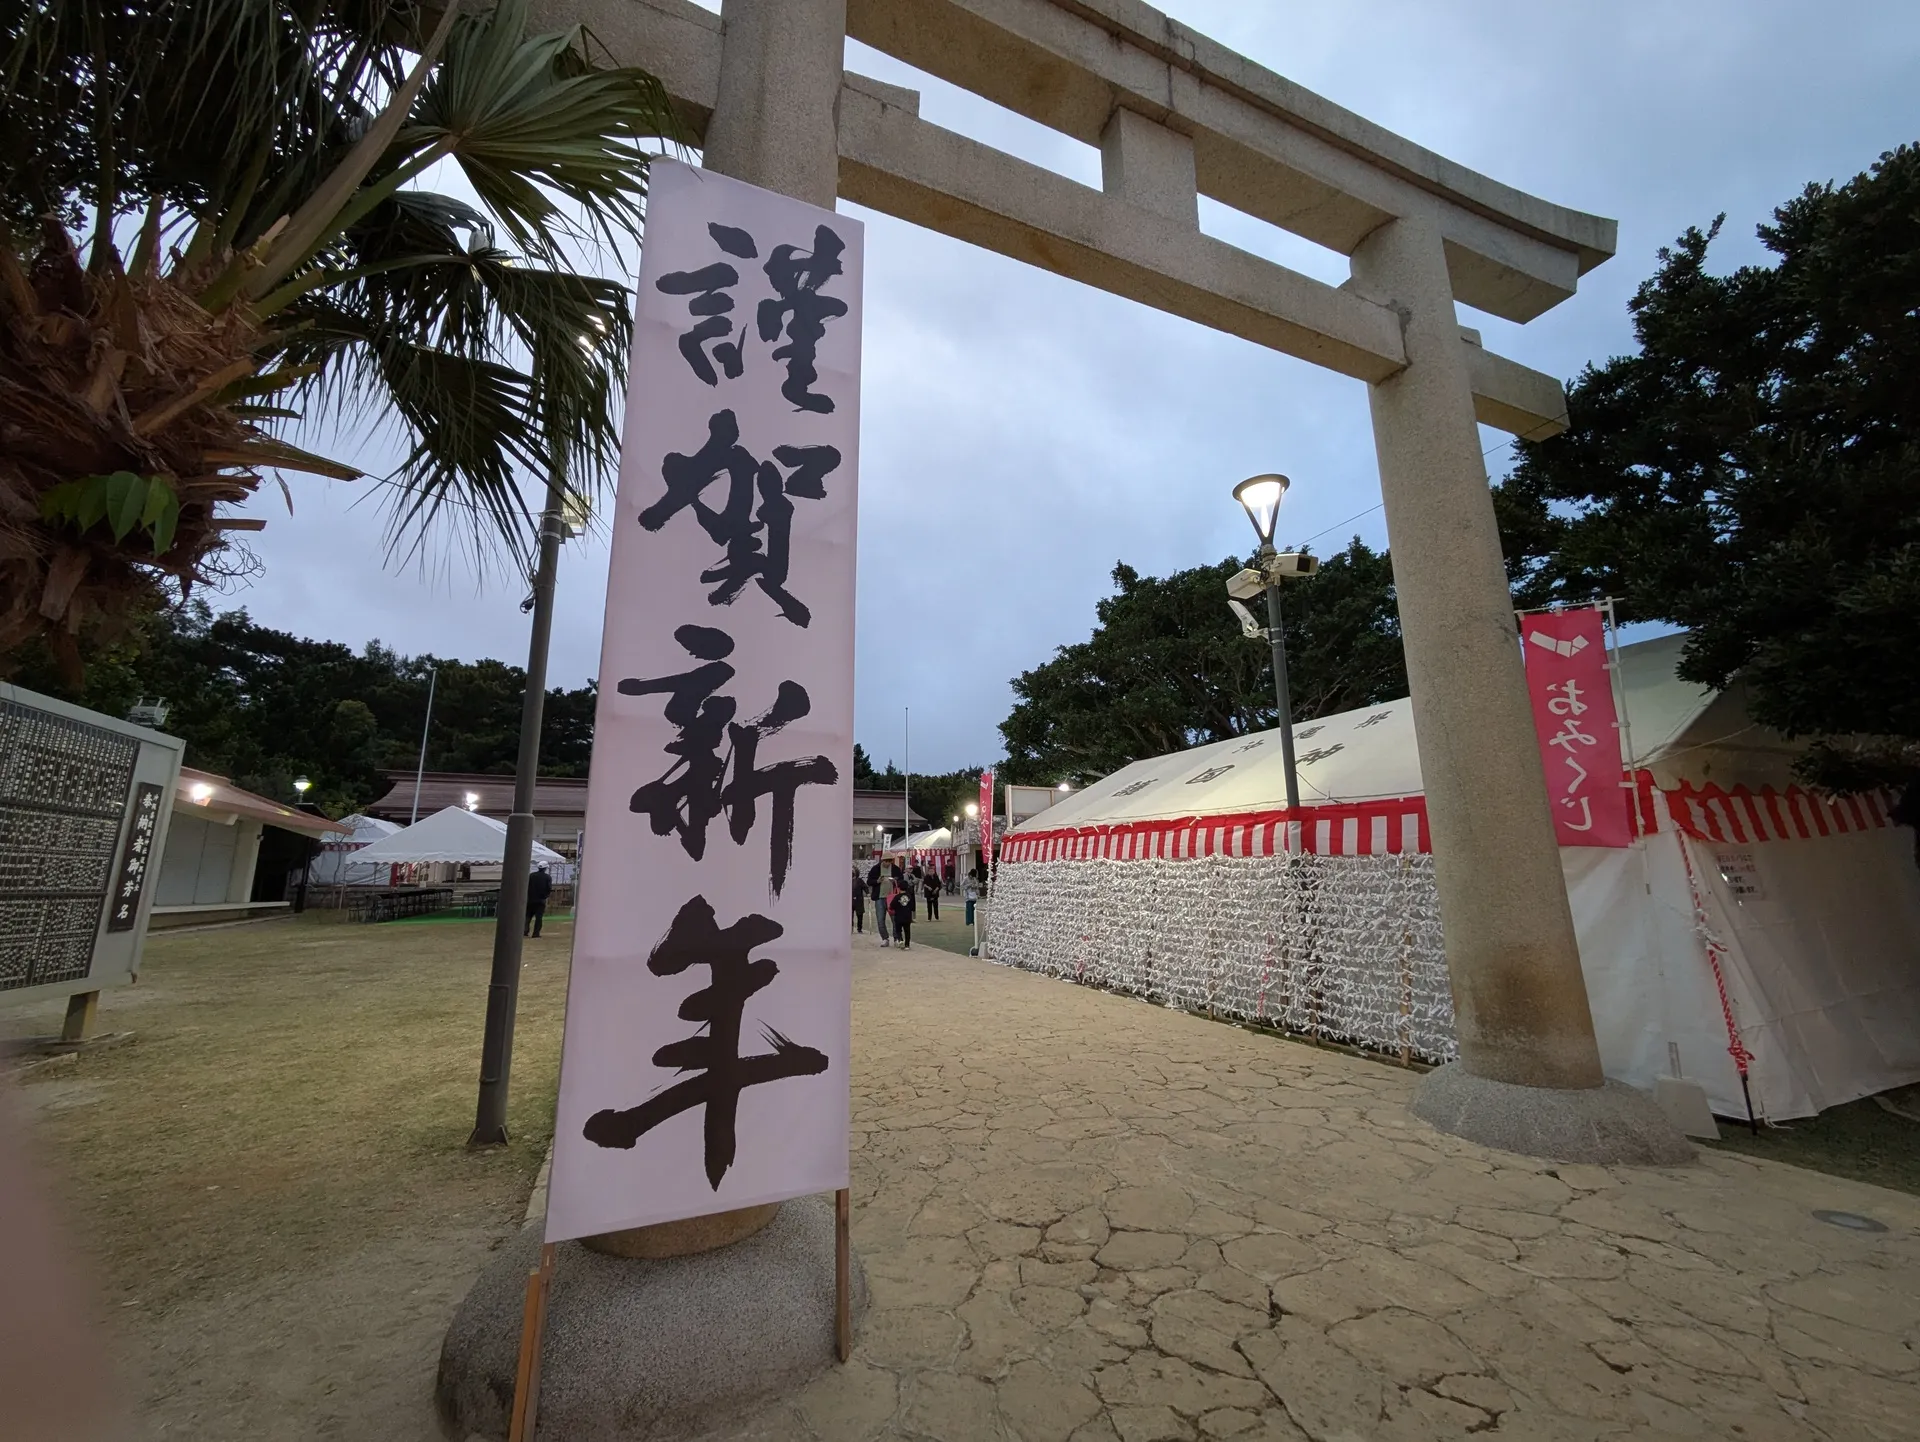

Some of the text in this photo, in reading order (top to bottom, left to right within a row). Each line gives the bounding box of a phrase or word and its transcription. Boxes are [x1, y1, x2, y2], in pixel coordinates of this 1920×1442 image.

[117, 792, 152, 919] 奉納者御芳名
[583, 221, 848, 1191] 謹賀新年
